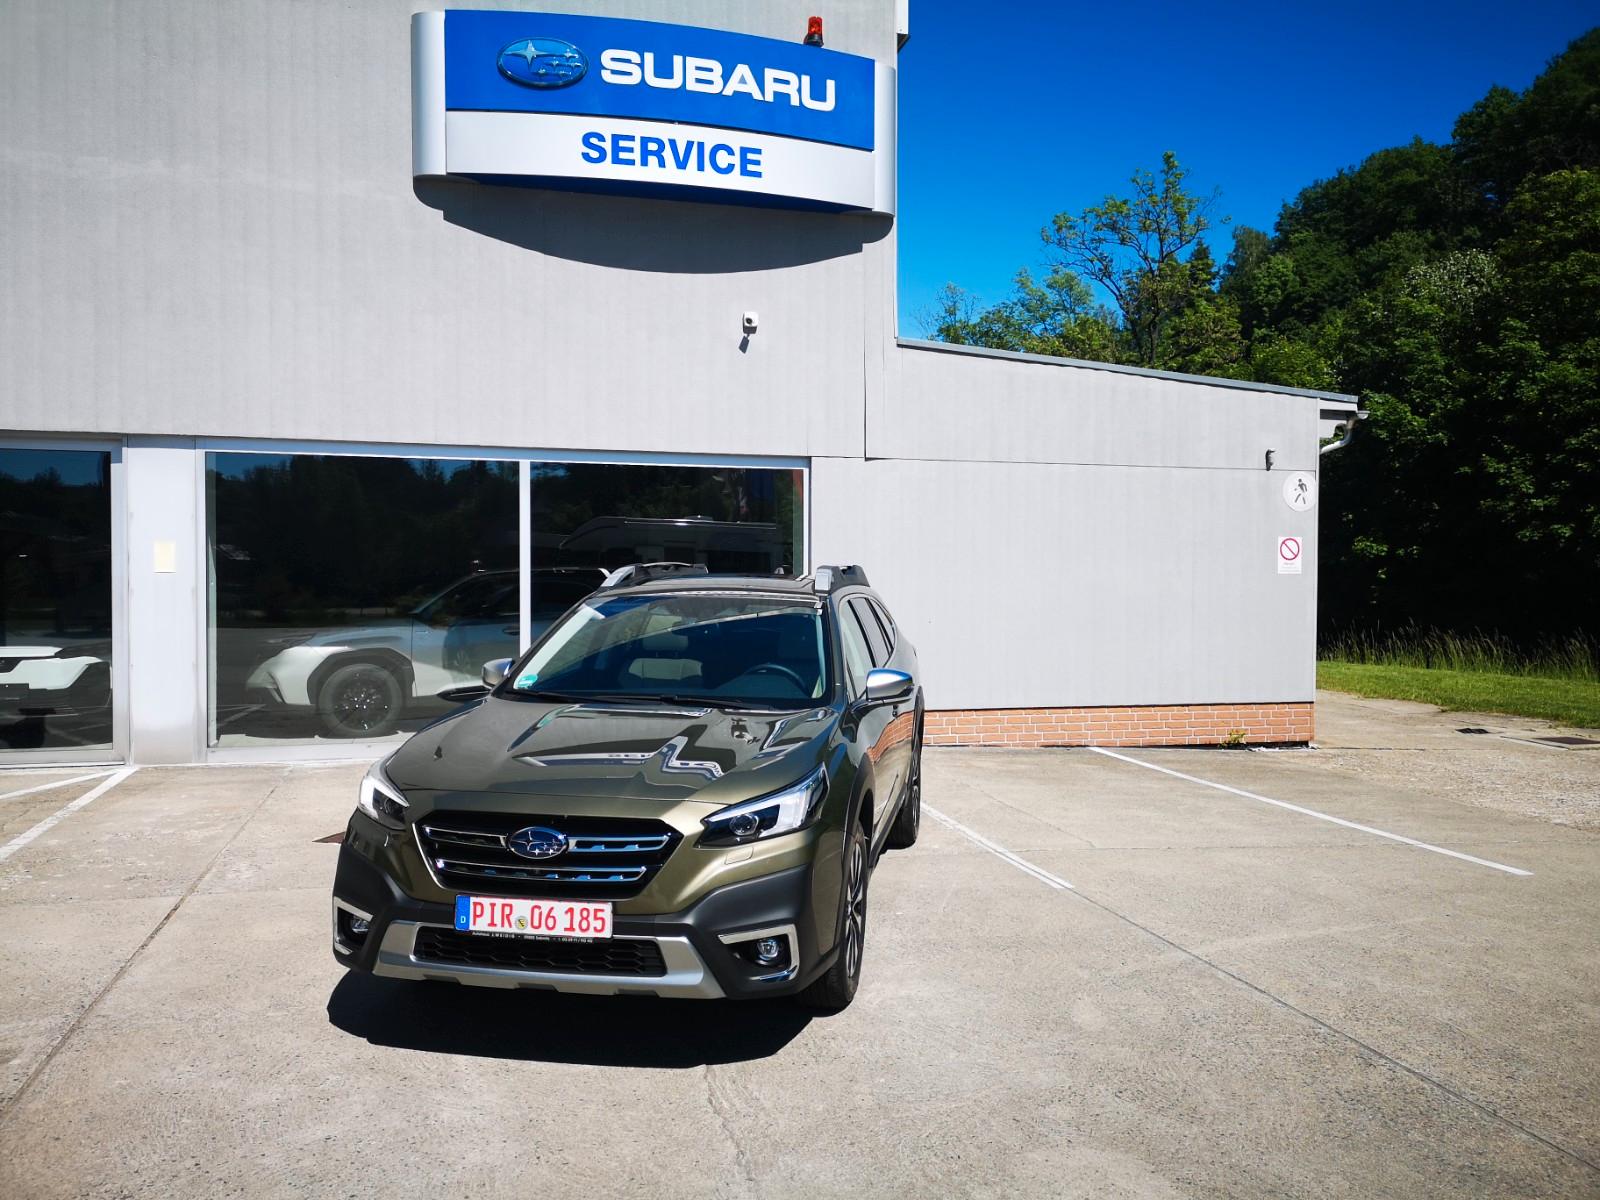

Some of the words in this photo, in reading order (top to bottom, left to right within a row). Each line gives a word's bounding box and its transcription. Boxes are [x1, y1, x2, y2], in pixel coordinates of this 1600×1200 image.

[601, 48, 836, 112] SUBARU
[581, 131, 763, 179] SERVICE
[472, 901, 514, 929] PIR
